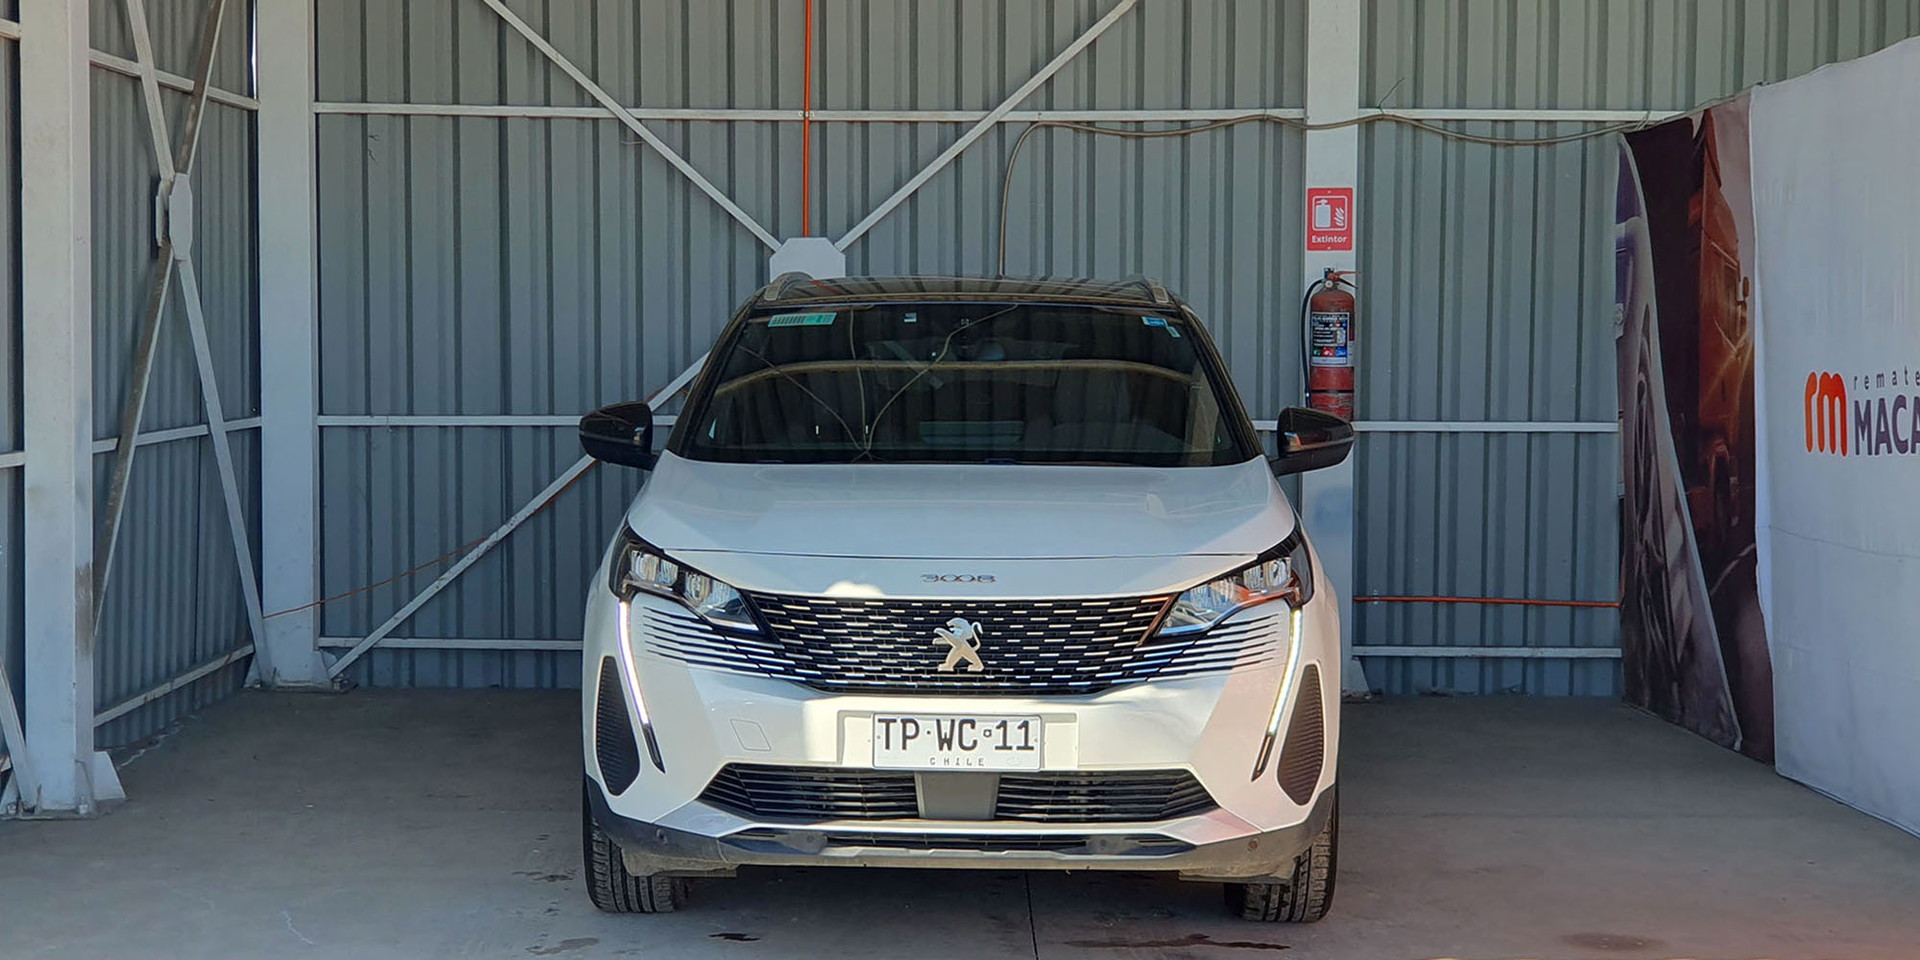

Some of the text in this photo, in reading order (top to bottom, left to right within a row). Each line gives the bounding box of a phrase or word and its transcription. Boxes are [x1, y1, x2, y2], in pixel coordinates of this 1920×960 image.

[1311, 235, 1348, 244] Extintor
[920, 573, 997, 583] 3008
[929, 757, 985, 766] CHILE
